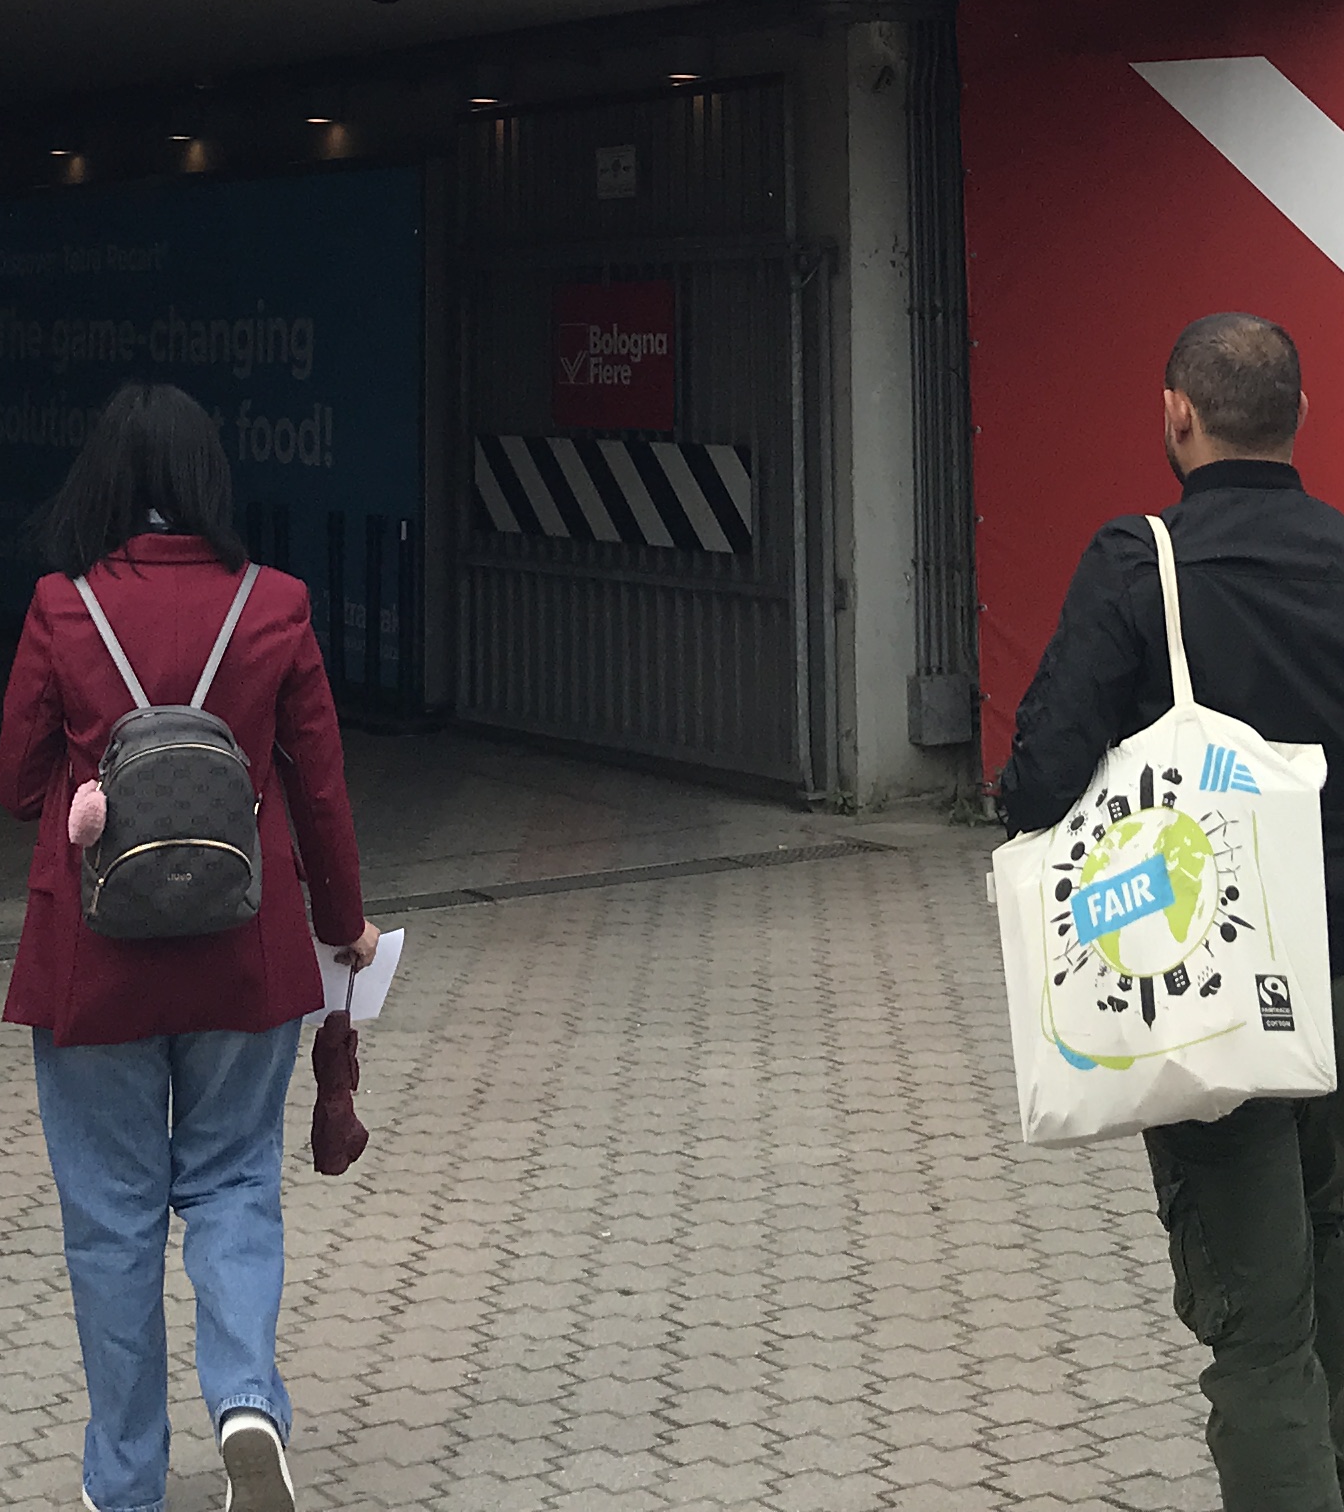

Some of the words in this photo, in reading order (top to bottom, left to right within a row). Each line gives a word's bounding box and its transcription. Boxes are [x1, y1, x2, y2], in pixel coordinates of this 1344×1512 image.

[52, 299, 315, 381] game-changing
[589, 323, 668, 363] Bologna
[590, 357, 632, 385] Fiere
[236, 399, 333, 469] food!
[1086, 872, 1155, 928] FAIR
